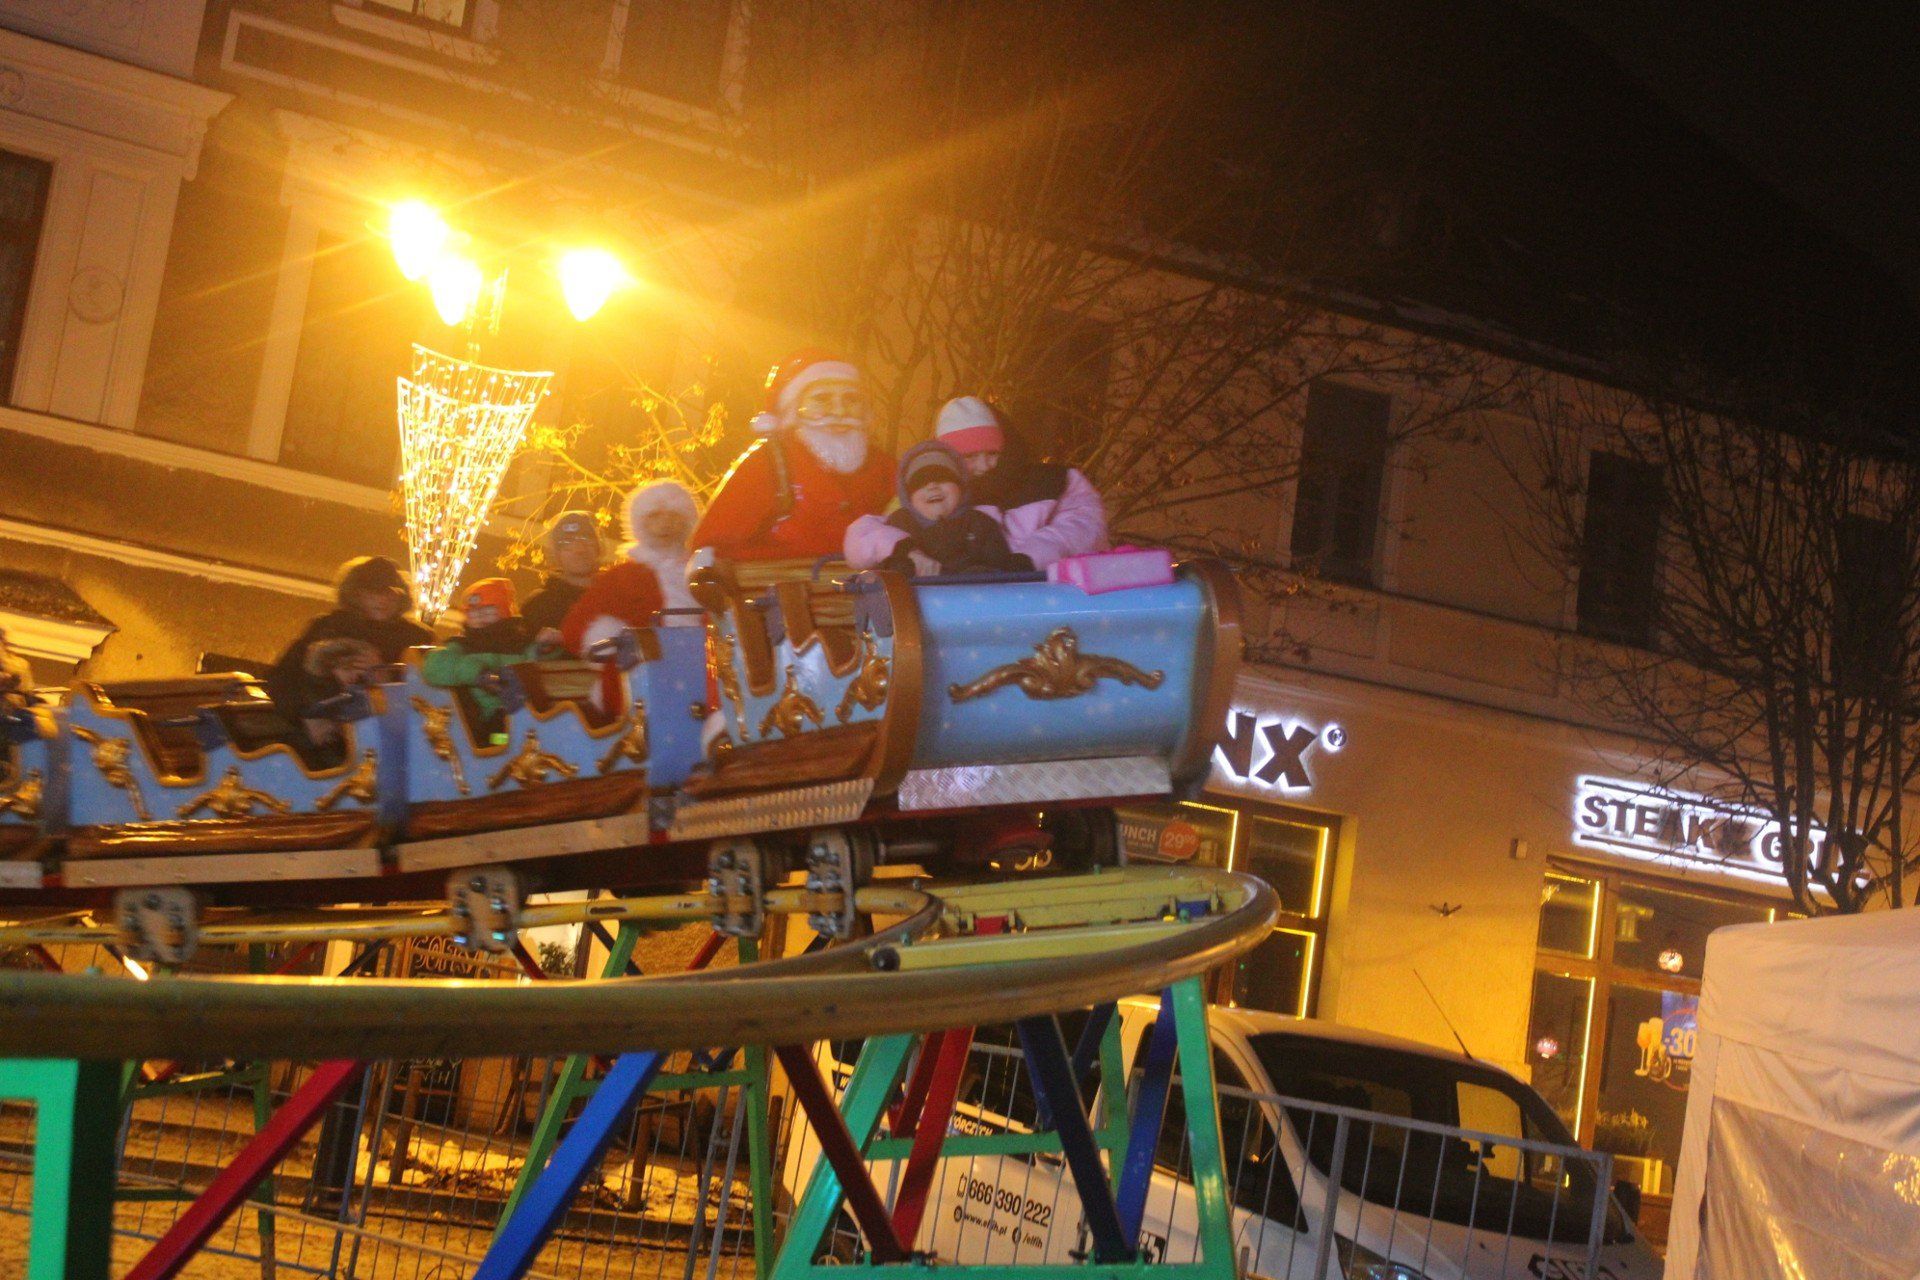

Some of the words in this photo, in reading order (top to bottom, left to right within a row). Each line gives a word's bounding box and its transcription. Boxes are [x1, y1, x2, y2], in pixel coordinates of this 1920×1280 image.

[1581, 795, 1716, 850] STEAK
[968, 1178, 994, 1205] 666
[995, 1188, 1021, 1216] 390
[1023, 1199, 1052, 1228] 222
